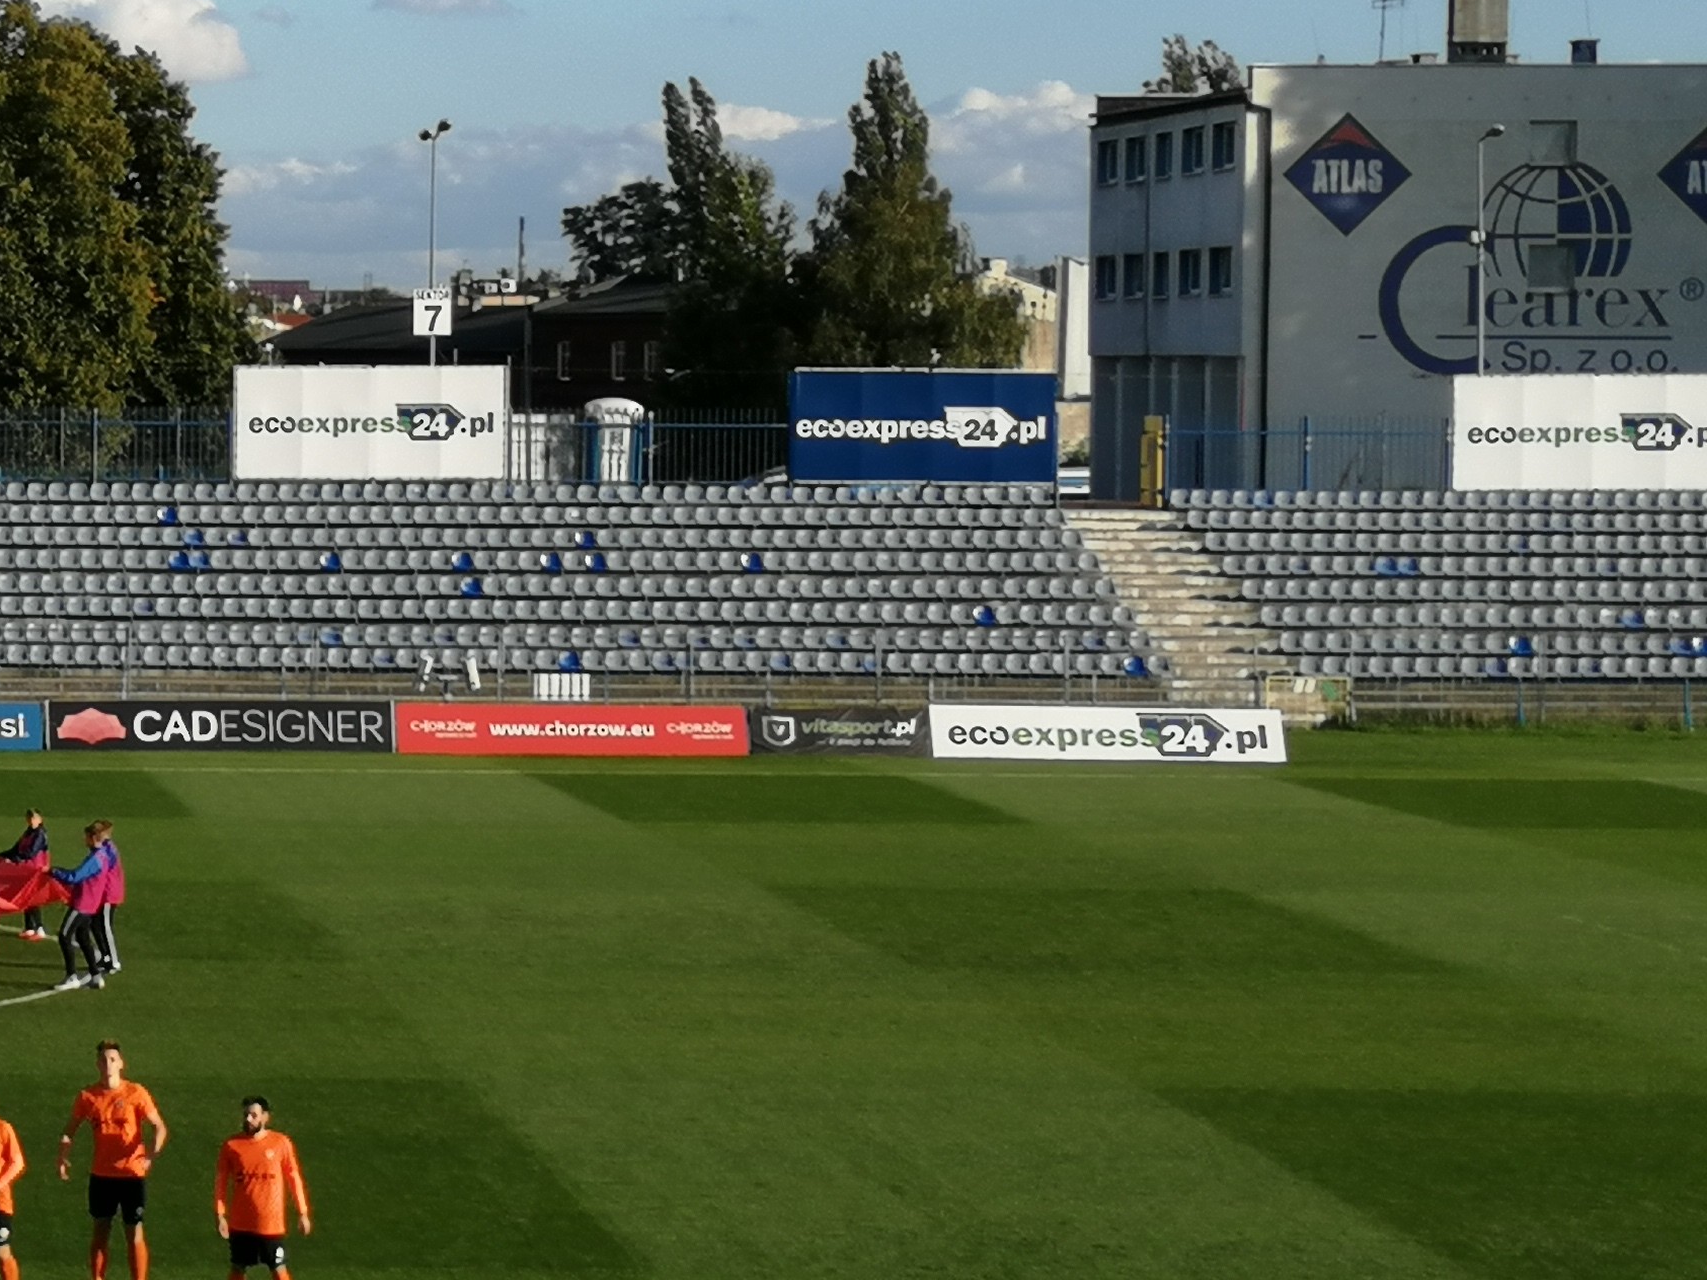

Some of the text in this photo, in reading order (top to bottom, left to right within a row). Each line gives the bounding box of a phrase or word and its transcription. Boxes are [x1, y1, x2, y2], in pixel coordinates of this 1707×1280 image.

[1312, 159, 1383, 194] ATLAS
[424, 305, 443, 332] 7
[1502, 341, 1563, 374] Sp.
[1576, 349, 1597, 371] z
[248, 411, 495, 438] ecoexpress24.pl
[795, 415, 1047, 445] ecoexpress24.pl
[1467, 421, 1707, 449] ecoexpress24.p
[132, 708, 385, 745] CADESIGNER
[489, 719, 655, 738] www.chorzow.eu
[800, 717, 918, 737] vitasport.pl
[947, 723, 1269, 755] ecoexpress24.pl
